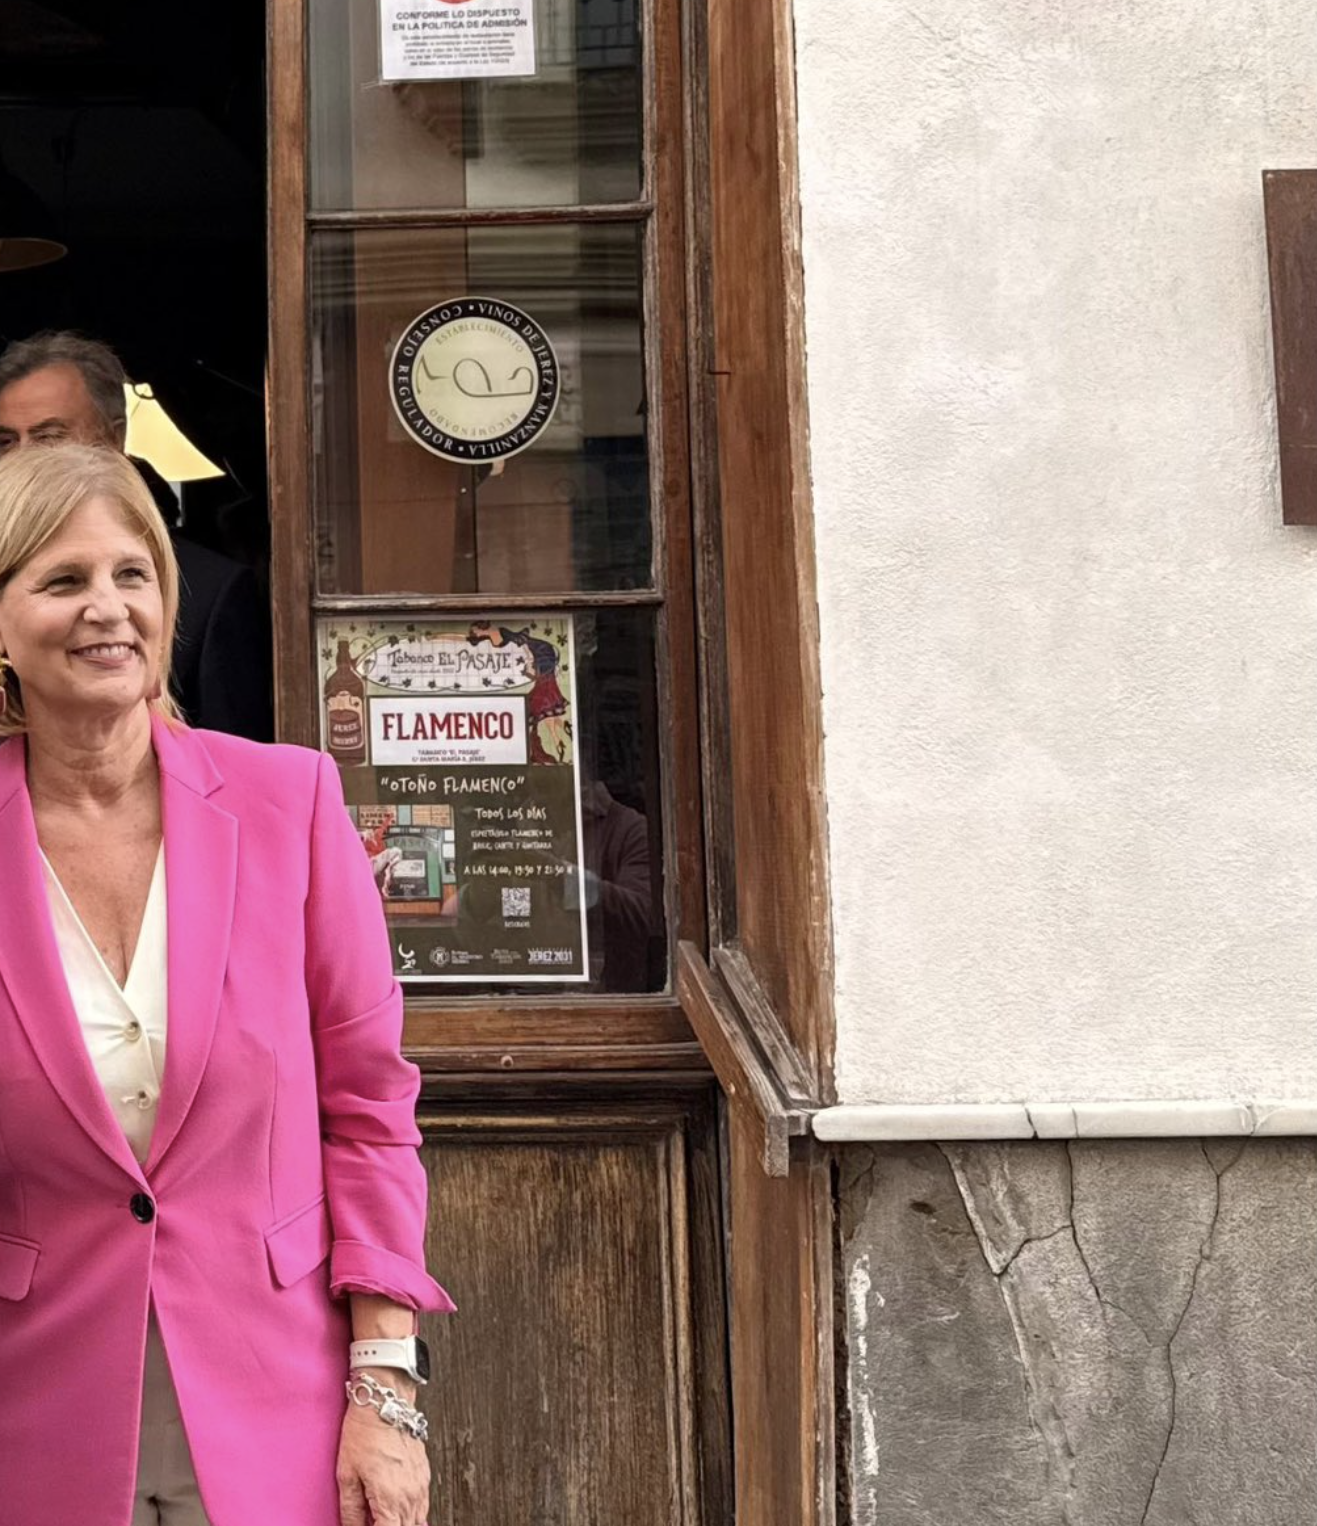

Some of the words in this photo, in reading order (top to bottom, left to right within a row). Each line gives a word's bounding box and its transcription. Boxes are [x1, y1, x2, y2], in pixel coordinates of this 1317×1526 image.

[392, 23, 405, 31] EN
[407, 22, 421, 31] LA
[466, 20, 480, 29] DE
[481, 17, 528, 29] ADMISIÓN
[396, 10, 450, 20] CONFORME
[452, 10, 465, 19] LO
[467, 8, 521, 18] DISPUESTO
[478, 303, 522, 327] VINOS
[403, 305, 462, 357] CONSEJO
[435, 322, 524, 353] ESTABLECIMIENTO
[521, 325, 540, 343] DE
[533, 344, 555, 387] JEREZ
[541, 390, 552, 400] Y
[398, 365, 454, 451] REGULADOR
[468, 403, 549, 456] MANZANILLA
[387, 650, 434, 667] Tabanco
[438, 652, 455, 666] EL
[455, 649, 512, 674] PASAJE
[382, 711, 514, 741] FLAMENCO
[474, 807, 504, 820] TODOS
[507, 807, 524, 821] LOS
[526, 806, 547, 820] DÍAS
[463, 865, 471, 875] A
[472, 864, 487, 875] LAS
